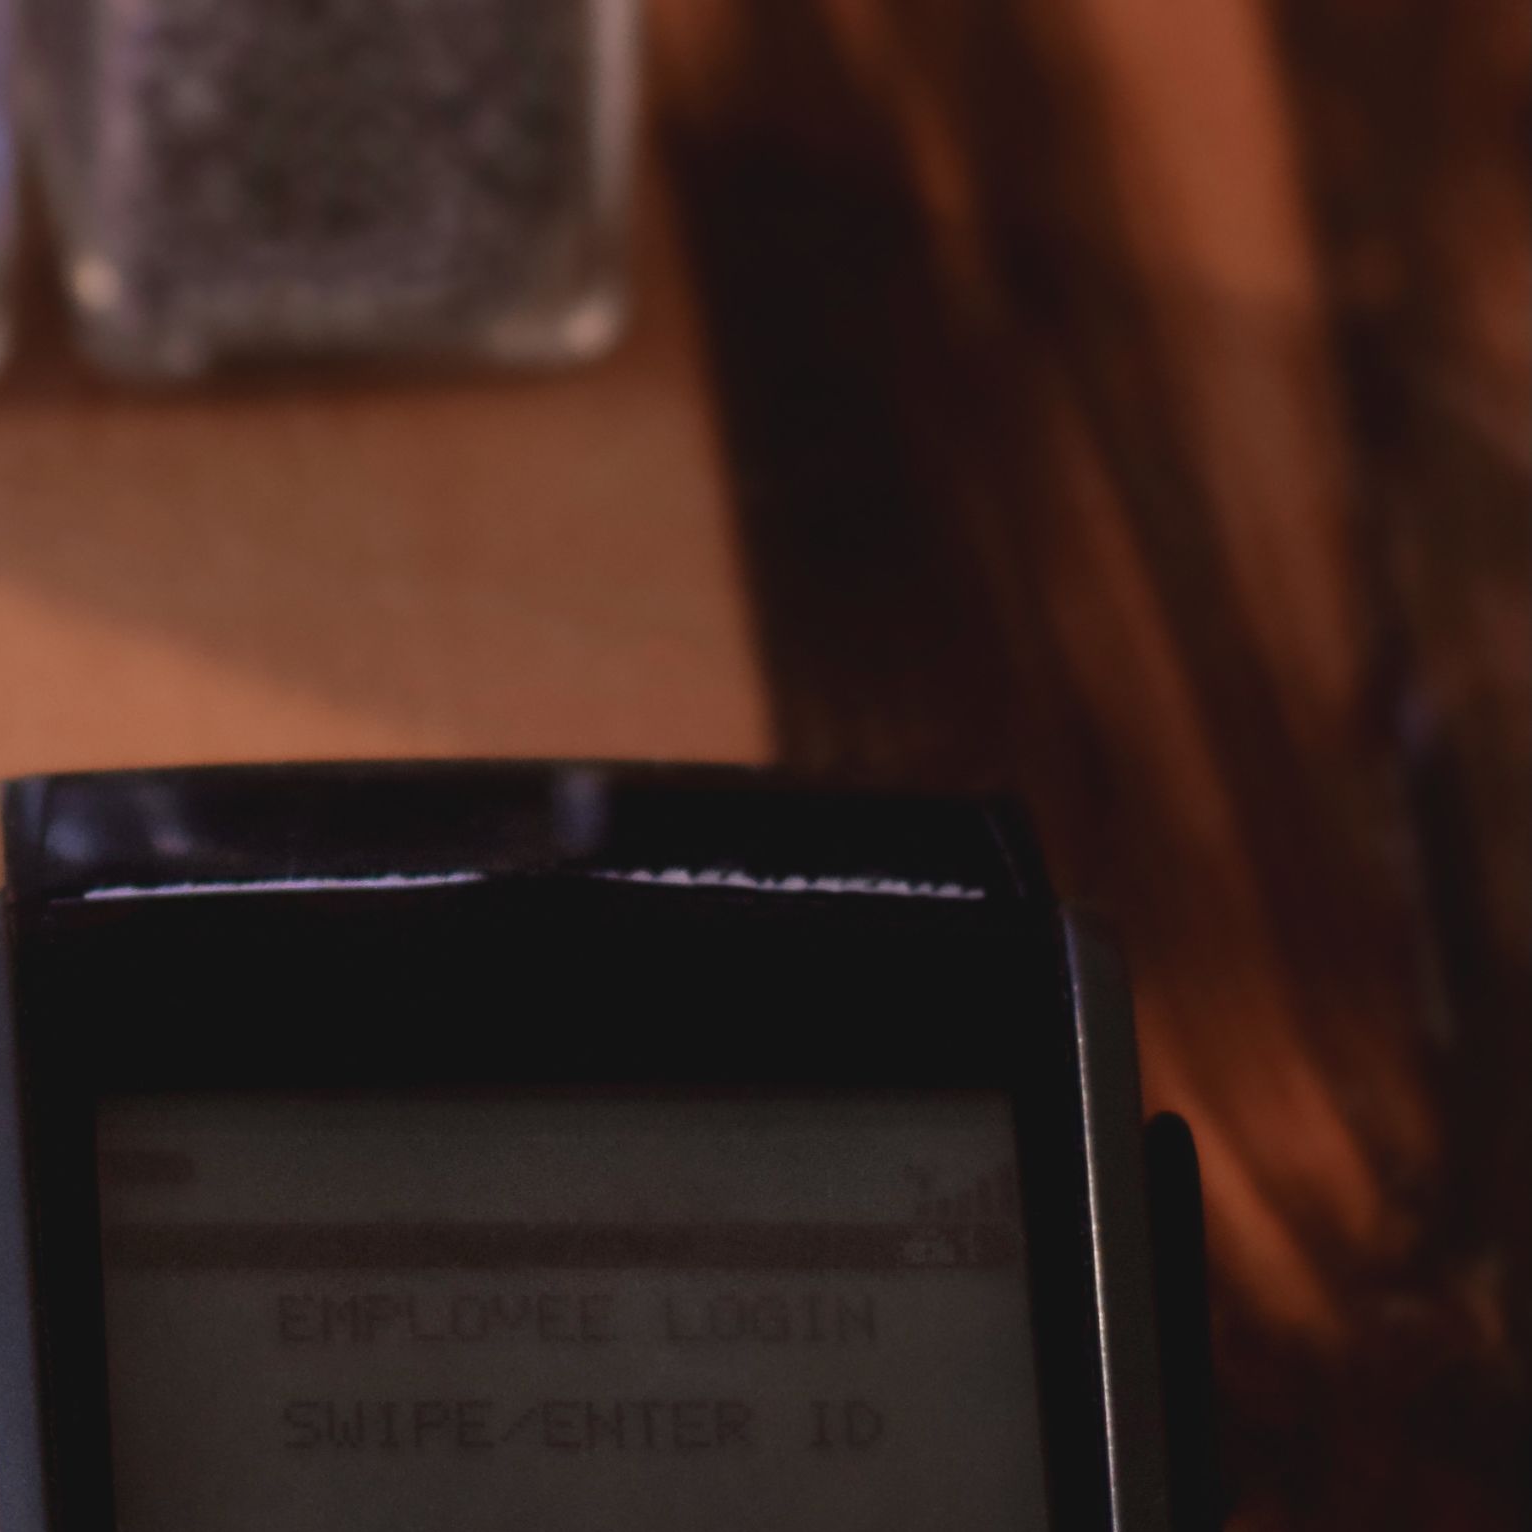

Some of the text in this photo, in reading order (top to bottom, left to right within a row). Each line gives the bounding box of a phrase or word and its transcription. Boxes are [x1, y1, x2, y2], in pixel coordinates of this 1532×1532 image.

[275, 1291, 879, 1346] EMPLOYEE LOGIN
[281, 1397, 887, 1453] SWIPE/ENTER ID
